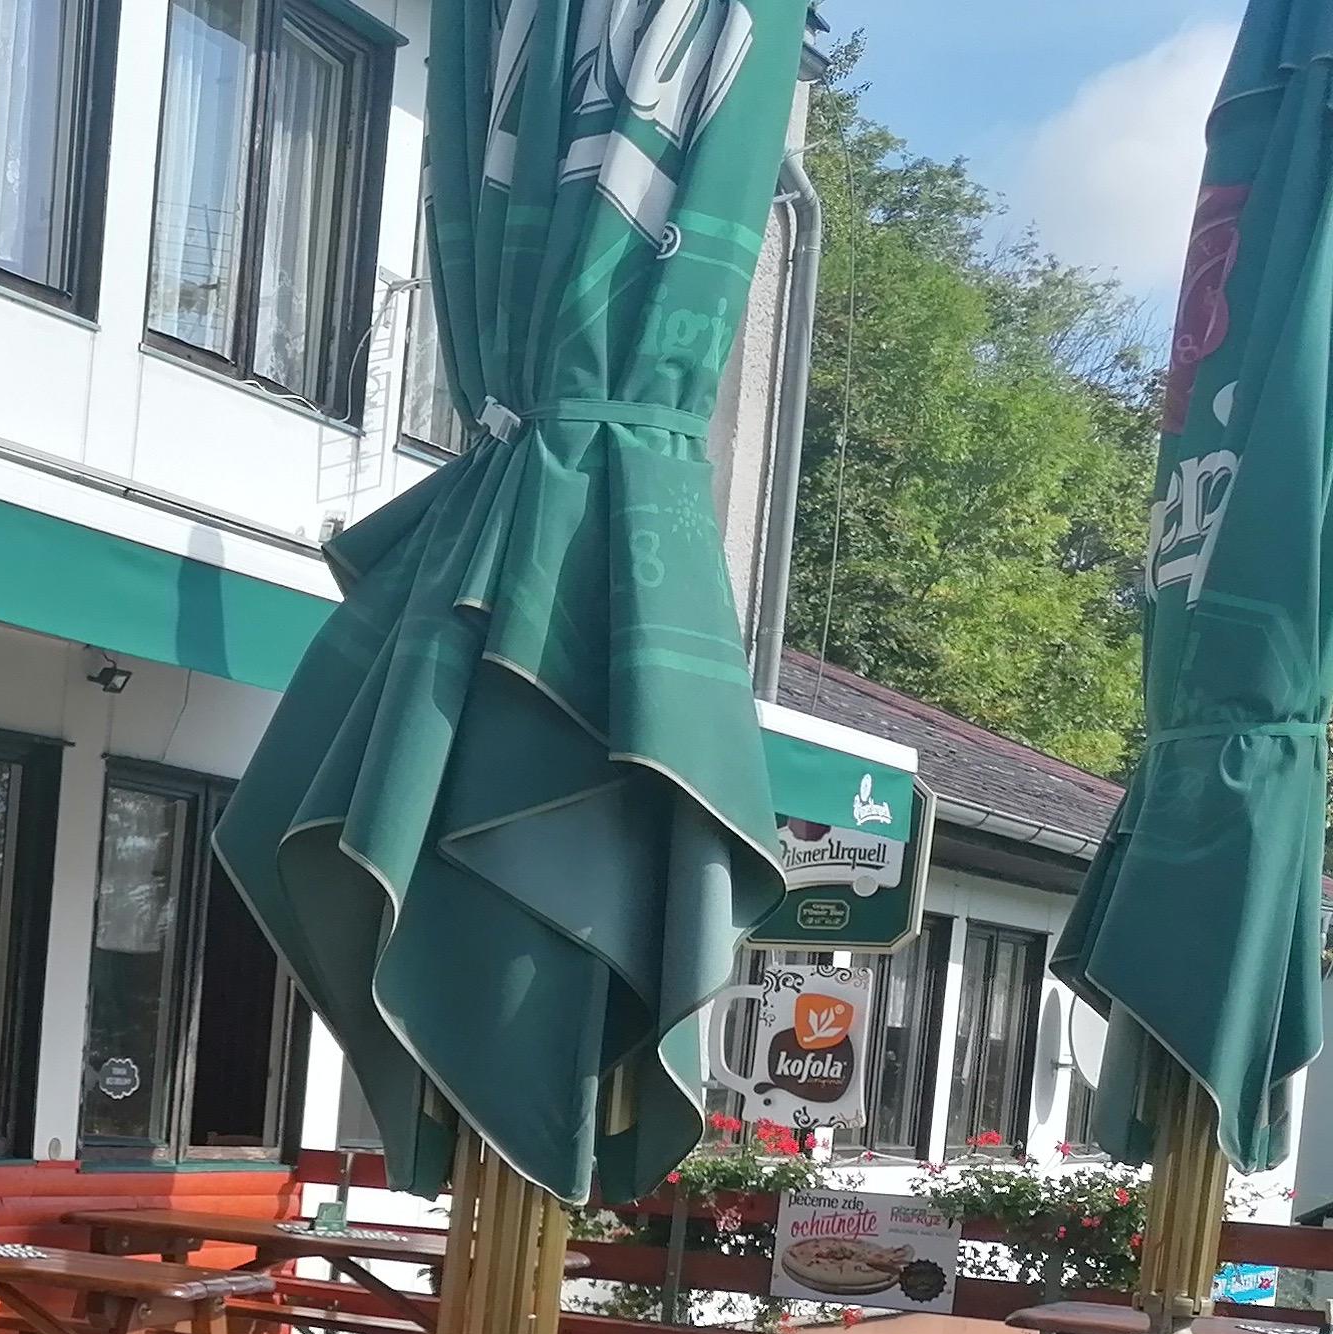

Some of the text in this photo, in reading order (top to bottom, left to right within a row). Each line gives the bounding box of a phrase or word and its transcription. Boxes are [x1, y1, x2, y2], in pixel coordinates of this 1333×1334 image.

[828, 838, 888, 871] Urquell
[775, 1050, 844, 1084] kofola
[788, 1192, 839, 1208] pečeme
